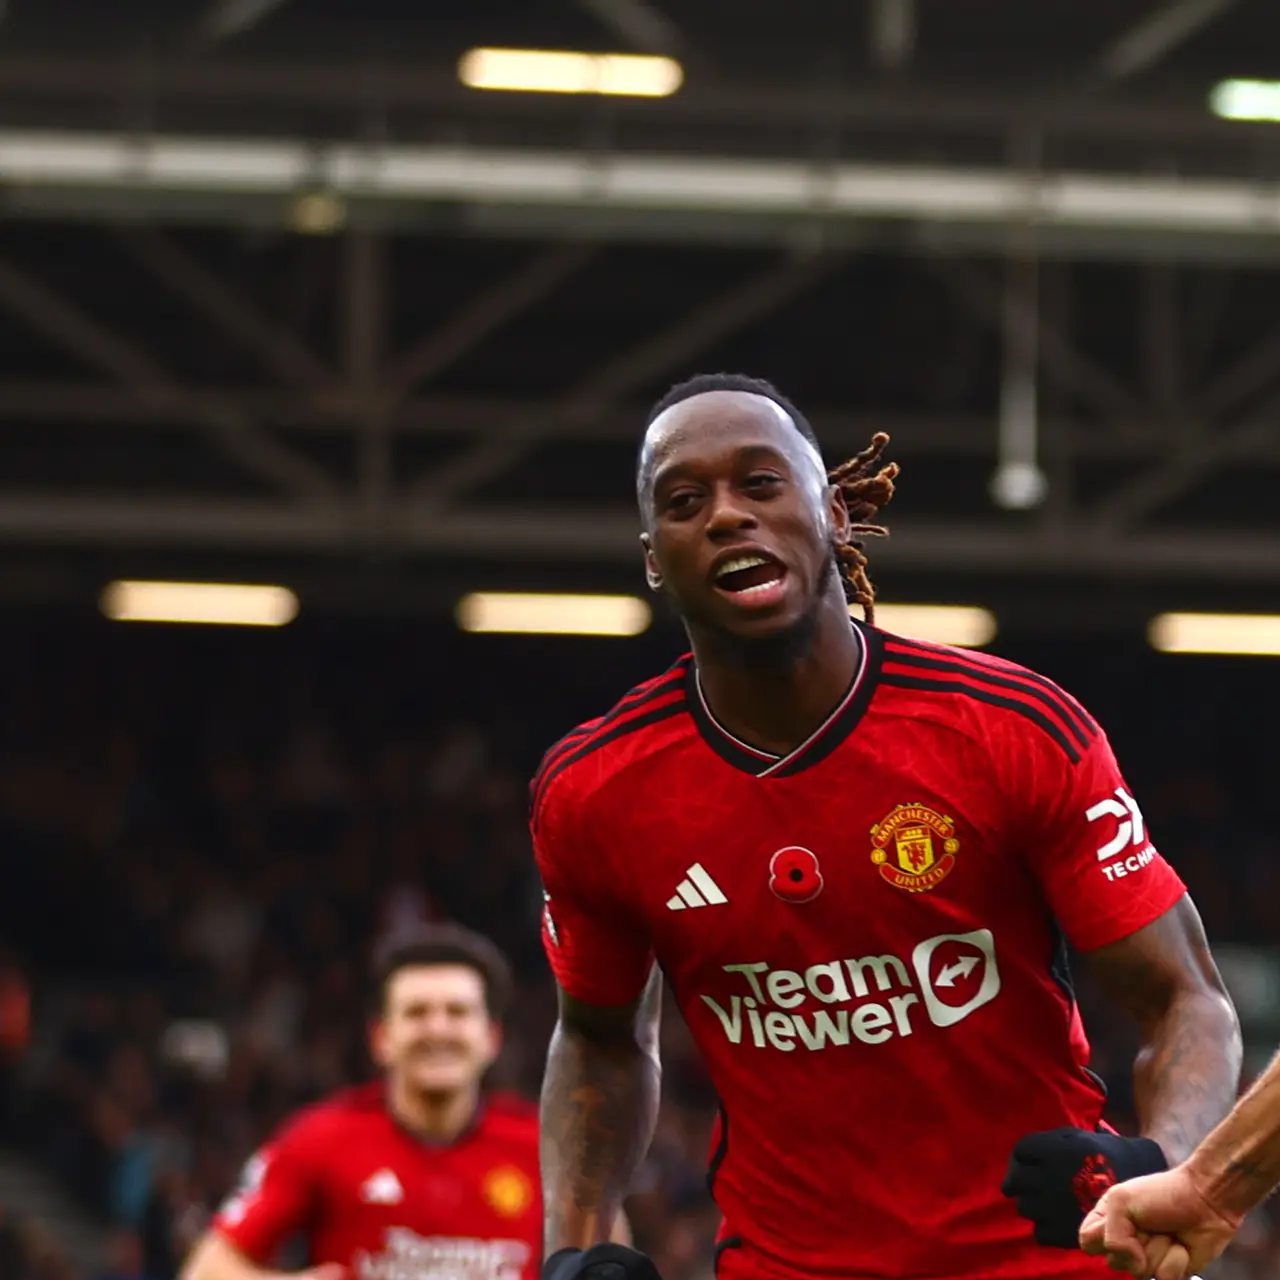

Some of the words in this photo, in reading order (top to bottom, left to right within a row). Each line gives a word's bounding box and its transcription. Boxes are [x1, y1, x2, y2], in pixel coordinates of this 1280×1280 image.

[877, 808, 949, 842] MANCHESTER
[894, 867, 944, 887] UNITED
[721, 954, 912, 1009] Team
[700, 992, 919, 1052] Viewer
